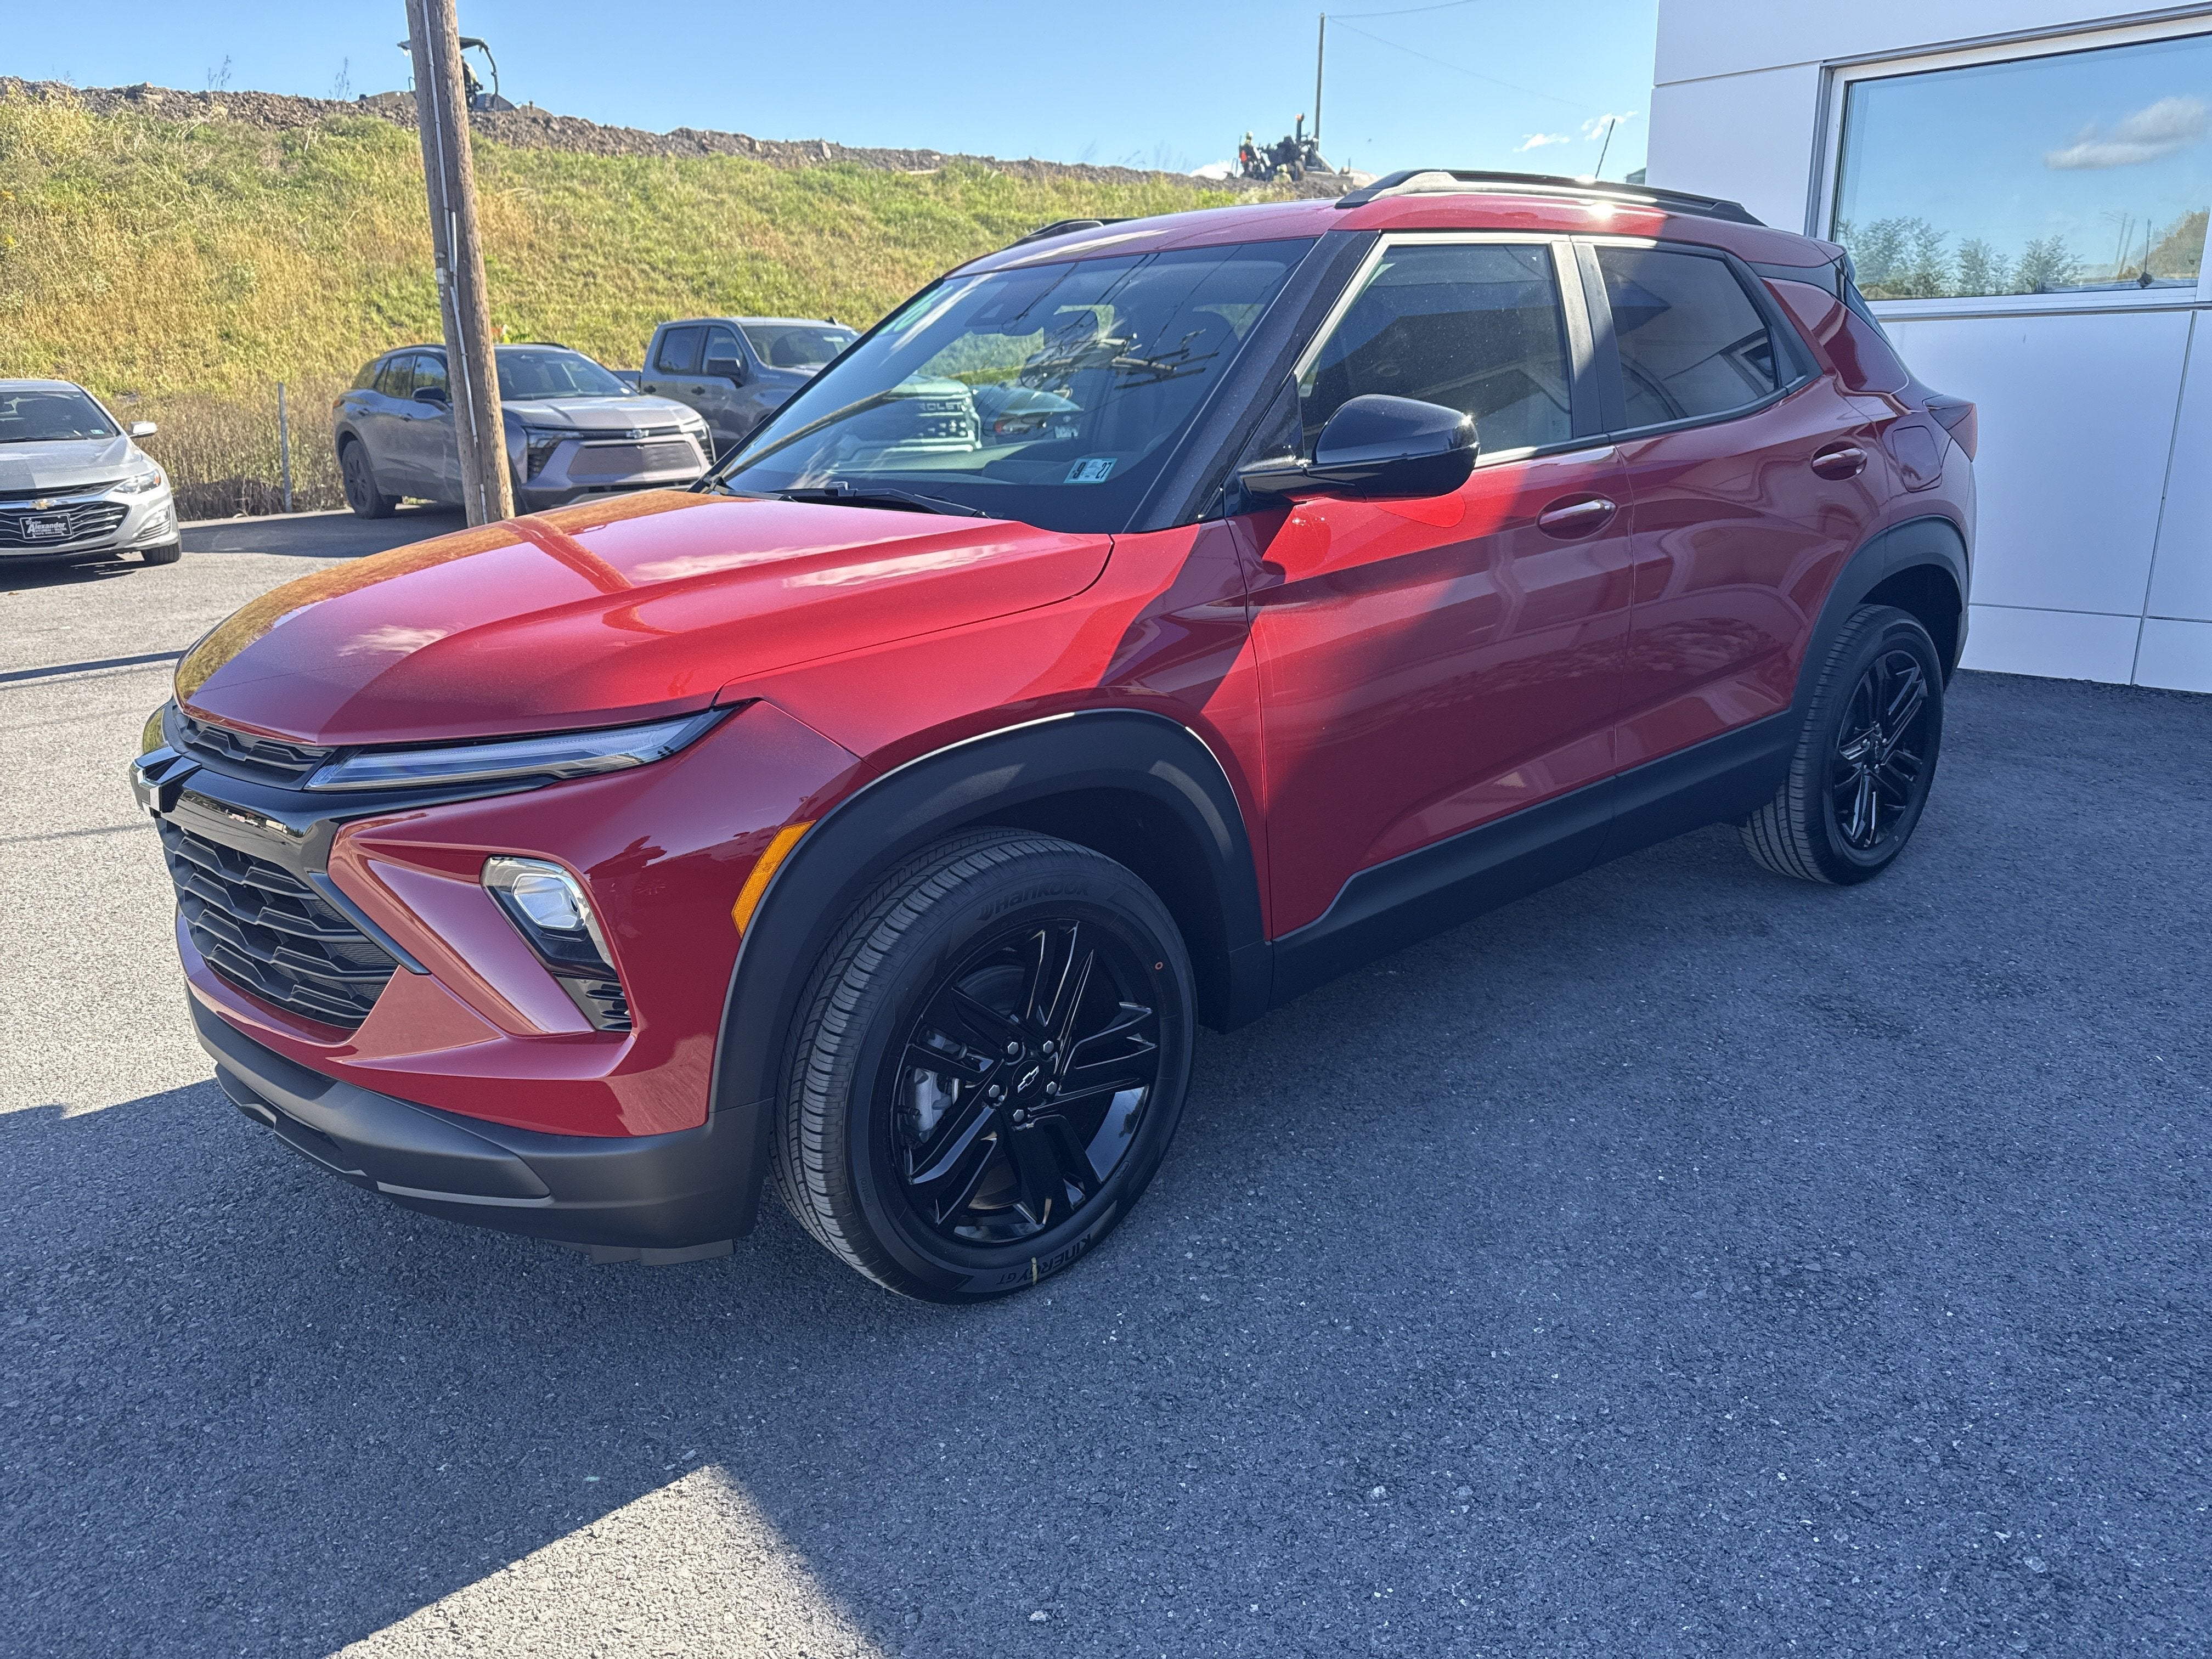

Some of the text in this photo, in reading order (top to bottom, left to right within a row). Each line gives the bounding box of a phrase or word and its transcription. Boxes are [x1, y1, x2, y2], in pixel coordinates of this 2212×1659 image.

[1095, 462, 1113, 479] 27
[27, 522, 66, 533] Alexander
[996, 1272, 1017, 1285] GT
